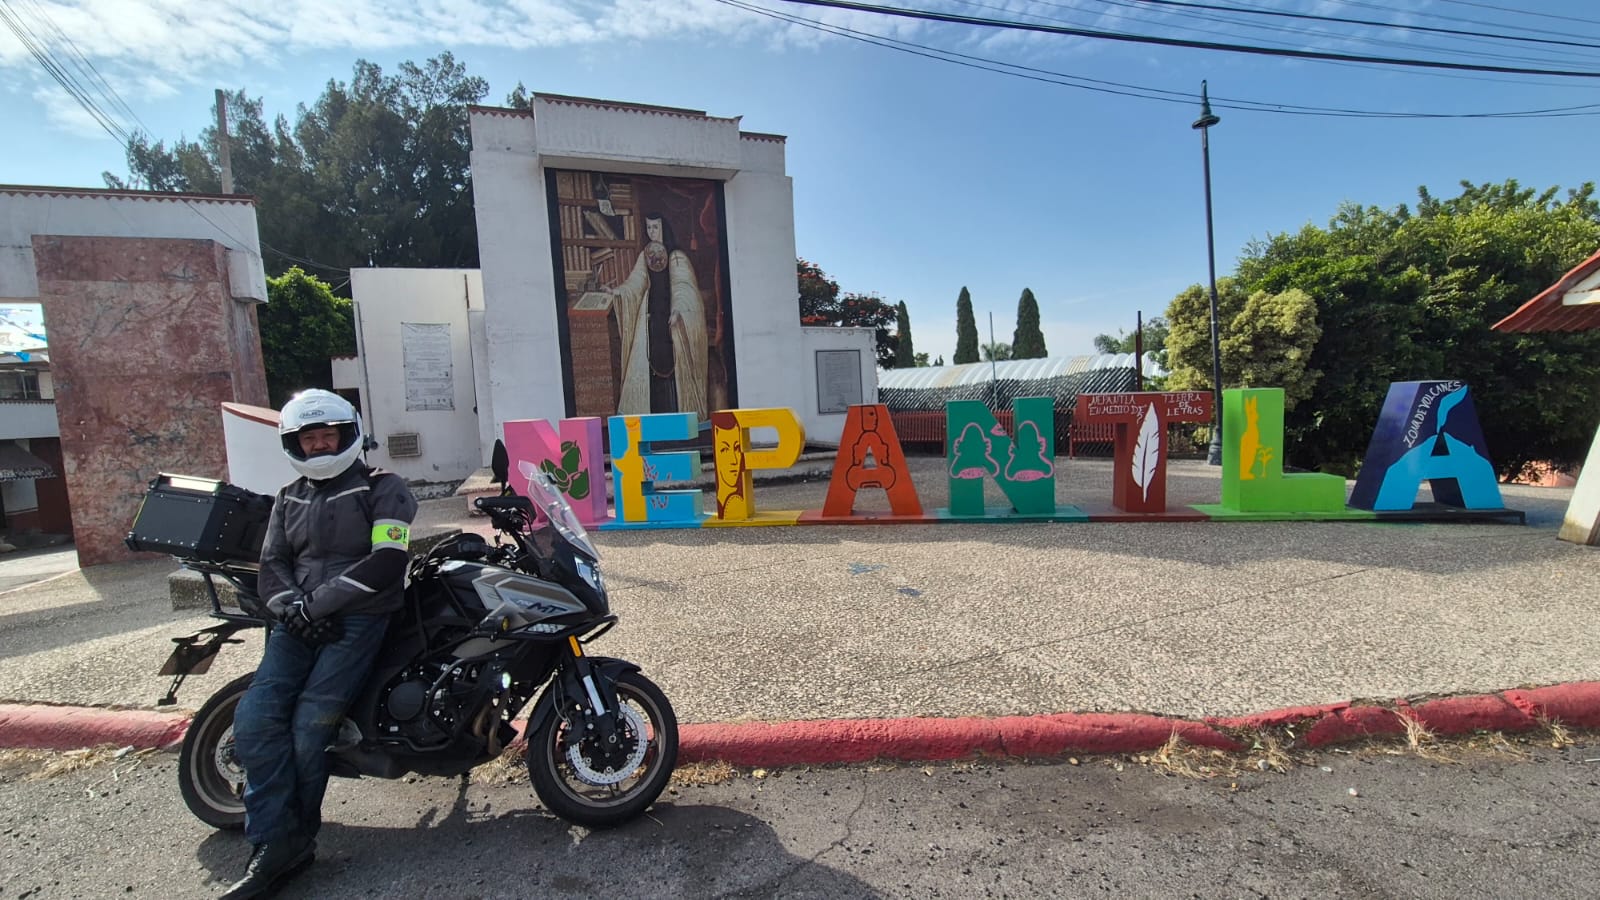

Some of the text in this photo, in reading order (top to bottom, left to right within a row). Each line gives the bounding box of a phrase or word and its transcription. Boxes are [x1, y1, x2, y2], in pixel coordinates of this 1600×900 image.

[1161, 392, 1202, 404] TIERRA
[1102, 405, 1130, 415] MEDIO
[1166, 406, 1204, 417] LETRAS
[1403, 381, 1461, 448] ZONA DE VOLCANES
[503, 380, 1505, 524] NEPANTLA
